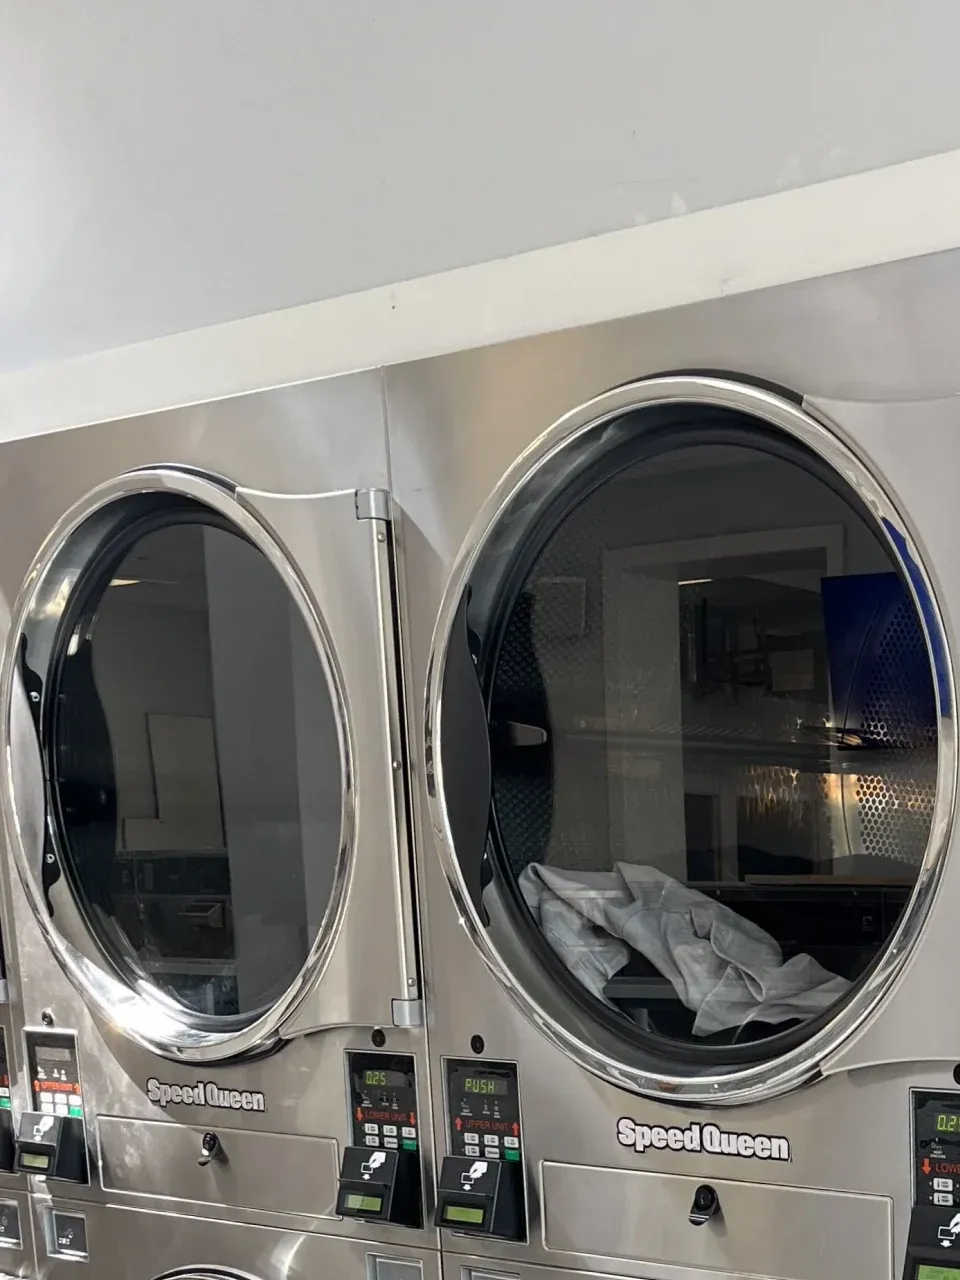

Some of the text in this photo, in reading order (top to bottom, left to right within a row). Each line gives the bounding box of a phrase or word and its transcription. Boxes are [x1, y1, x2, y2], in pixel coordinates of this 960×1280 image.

[366, 1071, 387, 1085] 0.25
[465, 1078, 496, 1093] PUSH
[146, 1077, 265, 1113] Speed Queen
[365, 1110, 390, 1121] LOWER
[465, 1120, 491, 1131] UPPER
[617, 1116, 792, 1162] Speed Queen
